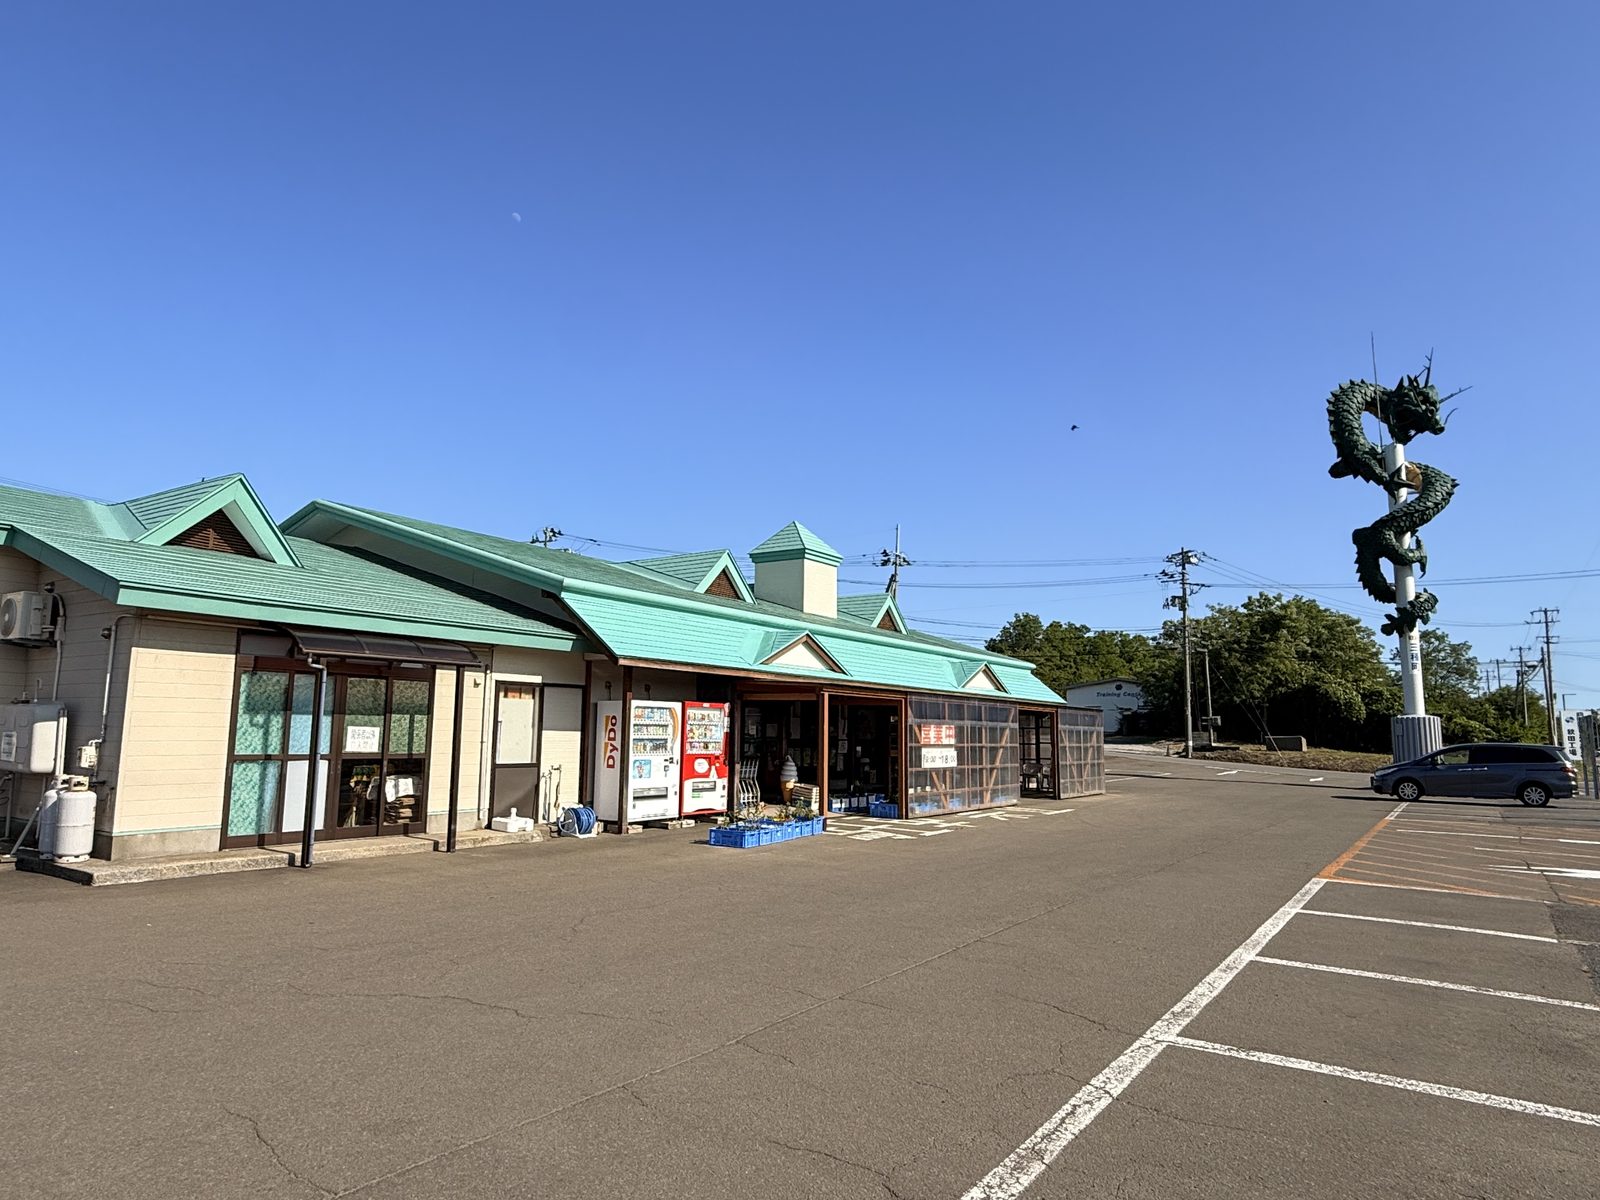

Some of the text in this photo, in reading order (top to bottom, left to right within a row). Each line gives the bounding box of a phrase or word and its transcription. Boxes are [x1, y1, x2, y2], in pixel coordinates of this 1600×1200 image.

[606, 715, 619, 769] DyDo
[922, 725, 955, 744] 営業中
